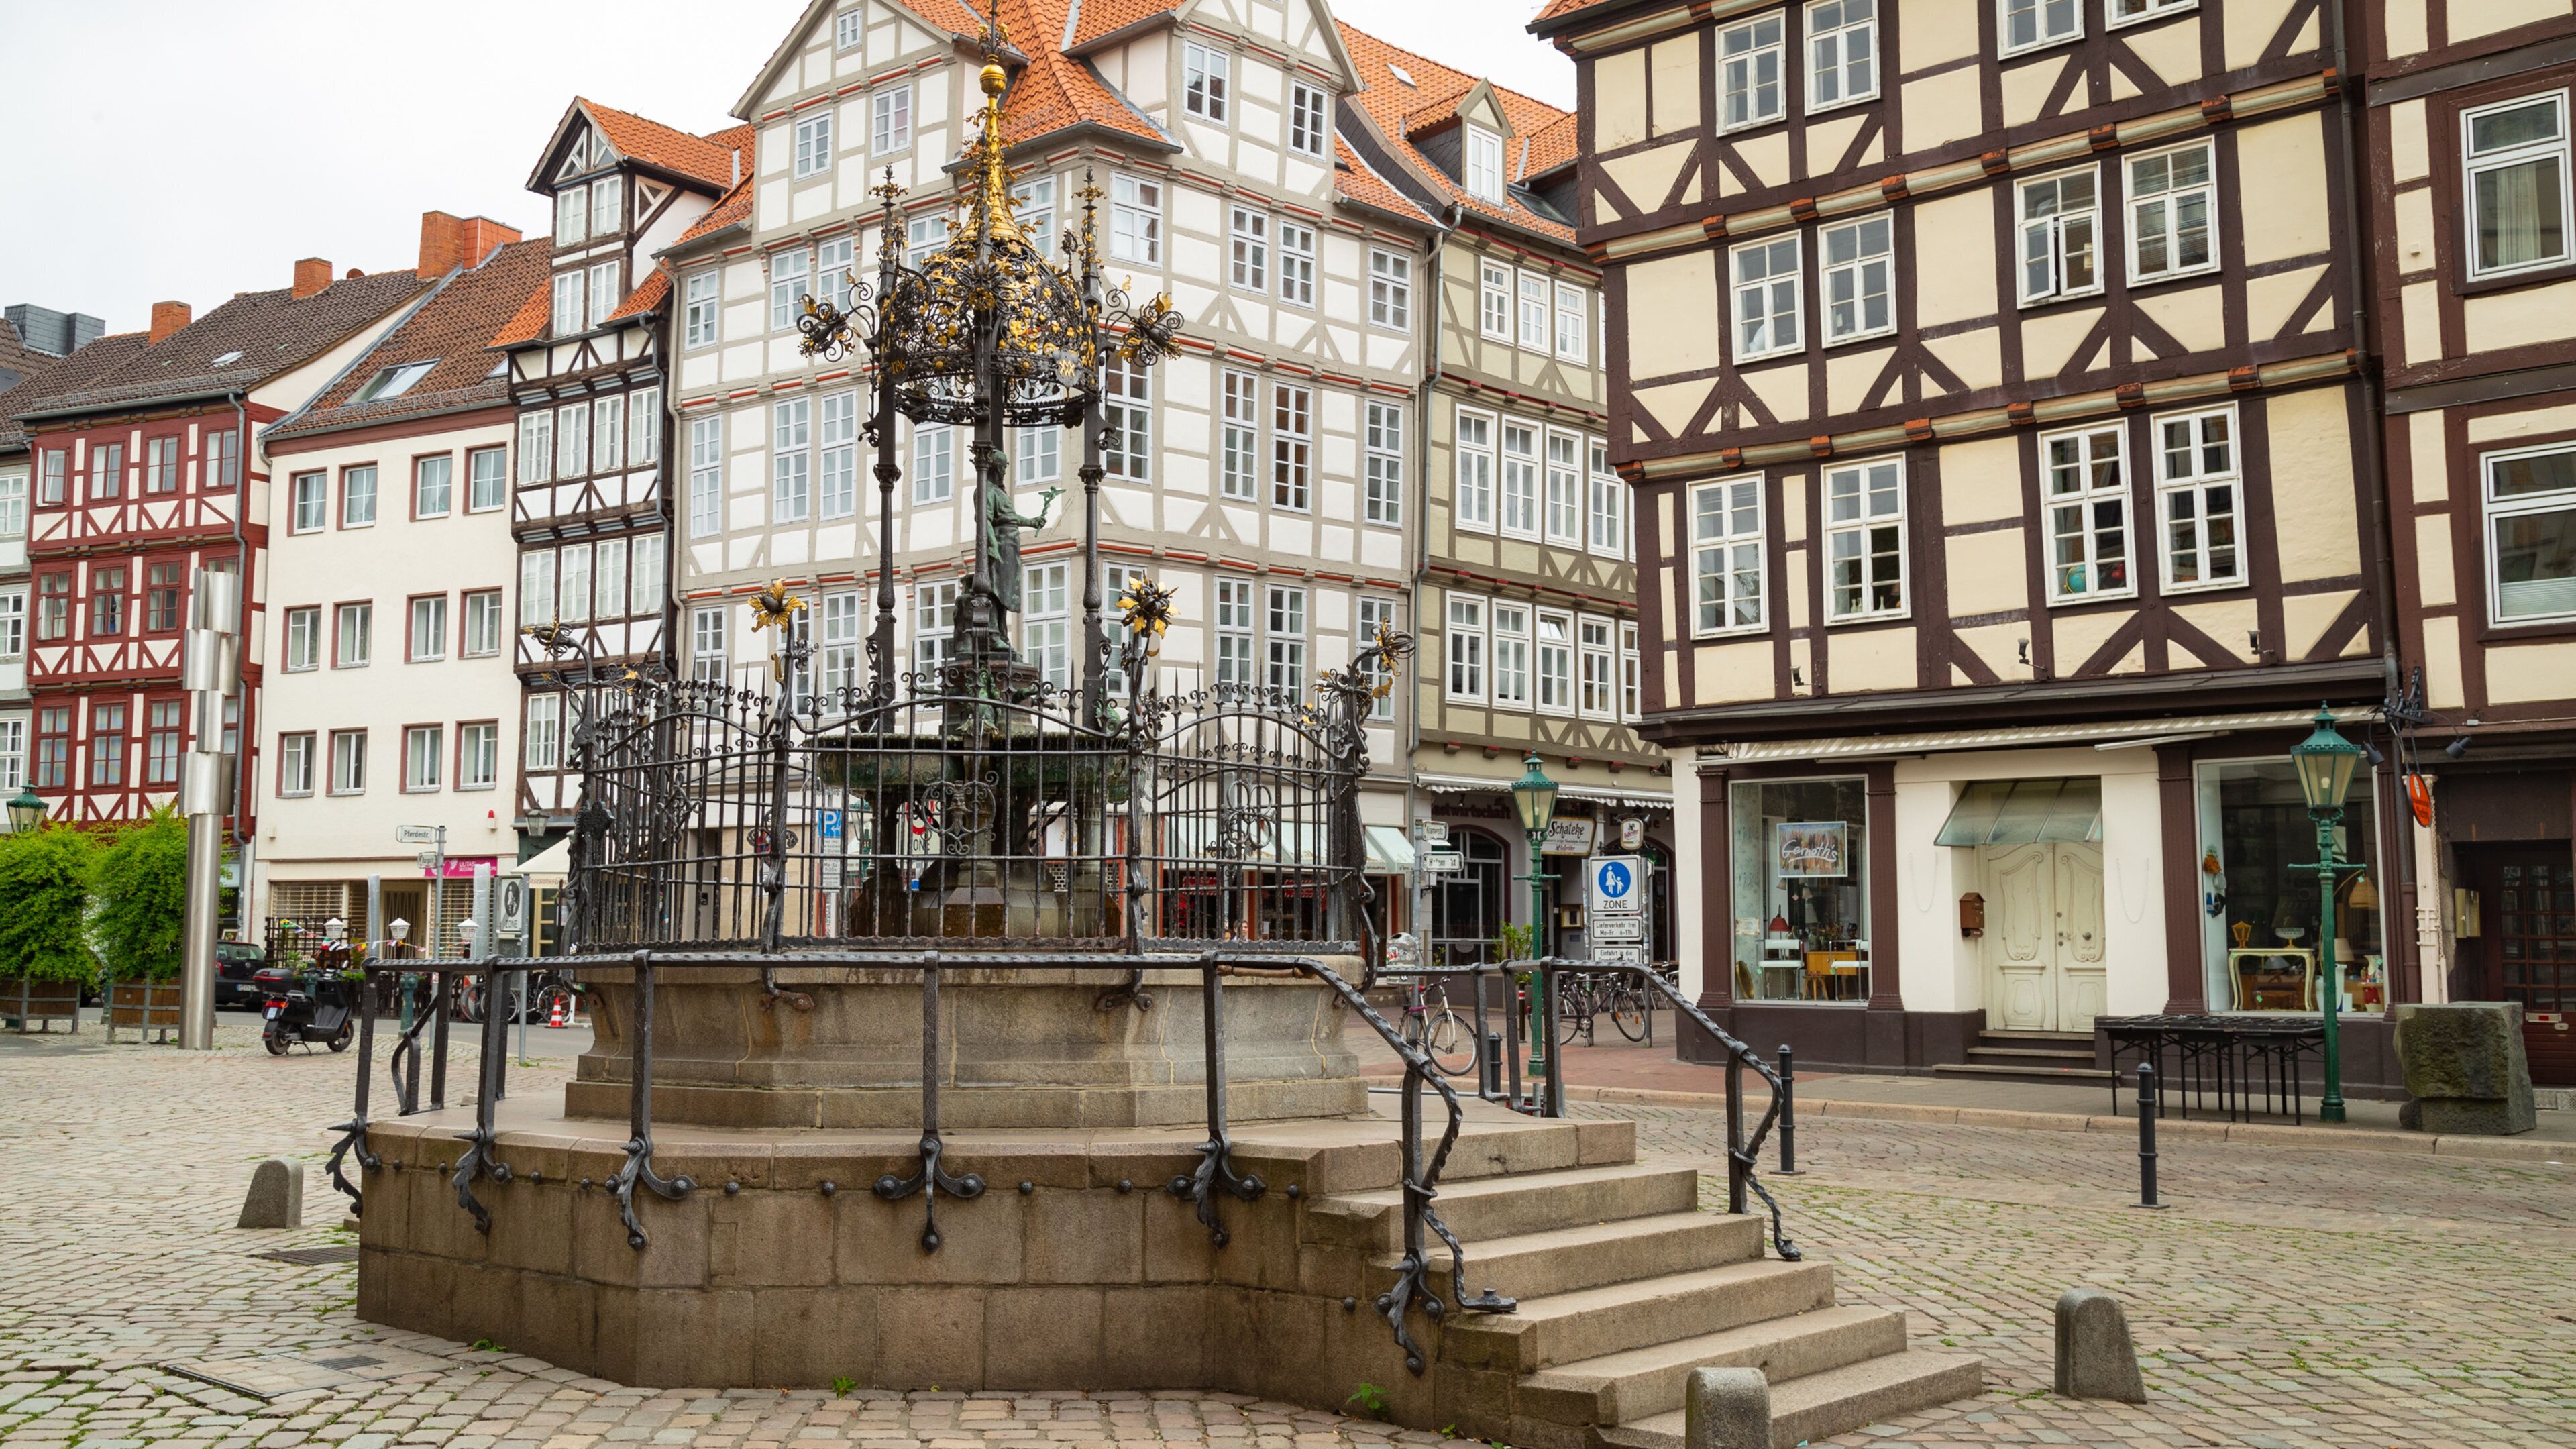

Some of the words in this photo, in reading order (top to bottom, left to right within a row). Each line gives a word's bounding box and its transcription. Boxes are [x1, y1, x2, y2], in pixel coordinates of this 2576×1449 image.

[824, 810, 837, 833] P
[404, 830, 429, 838] Pferdestr.
[1603, 900, 1627, 909] ZONE
